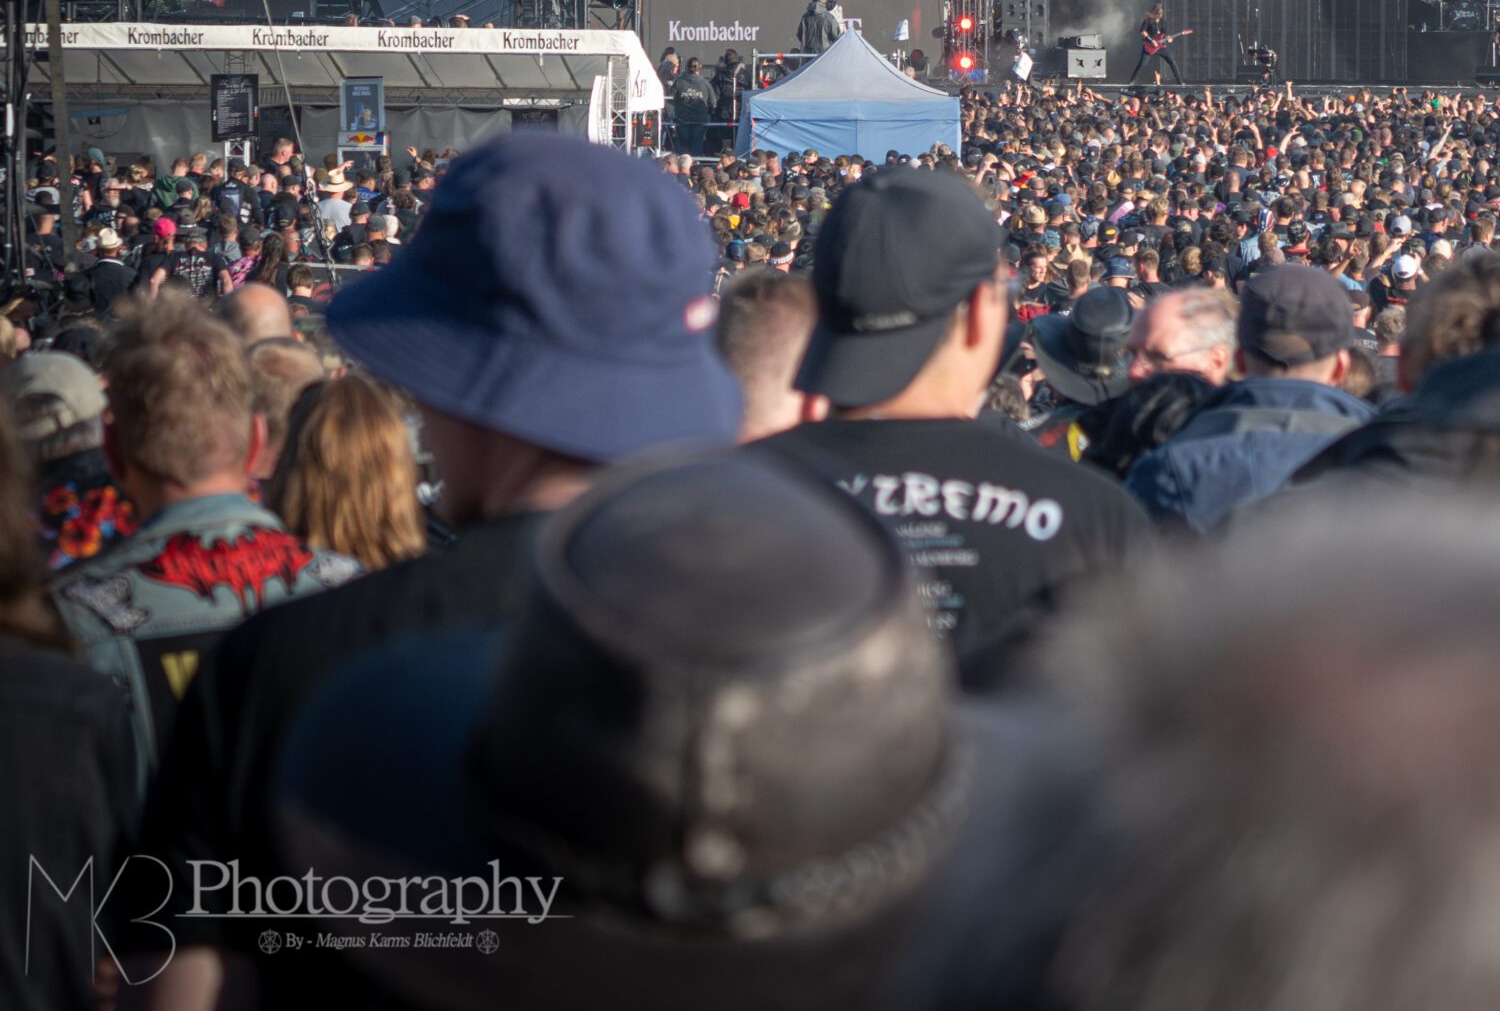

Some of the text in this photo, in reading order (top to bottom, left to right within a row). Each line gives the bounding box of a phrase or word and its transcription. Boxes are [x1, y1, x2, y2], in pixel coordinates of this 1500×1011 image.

[128, 27, 204, 45] Krombacher
[252, 28, 329, 47] Krombacher
[377, 30, 454, 49] Krombacher
[503, 31, 580, 50] Krombacher
[668, 20, 760, 42] Krombacher
